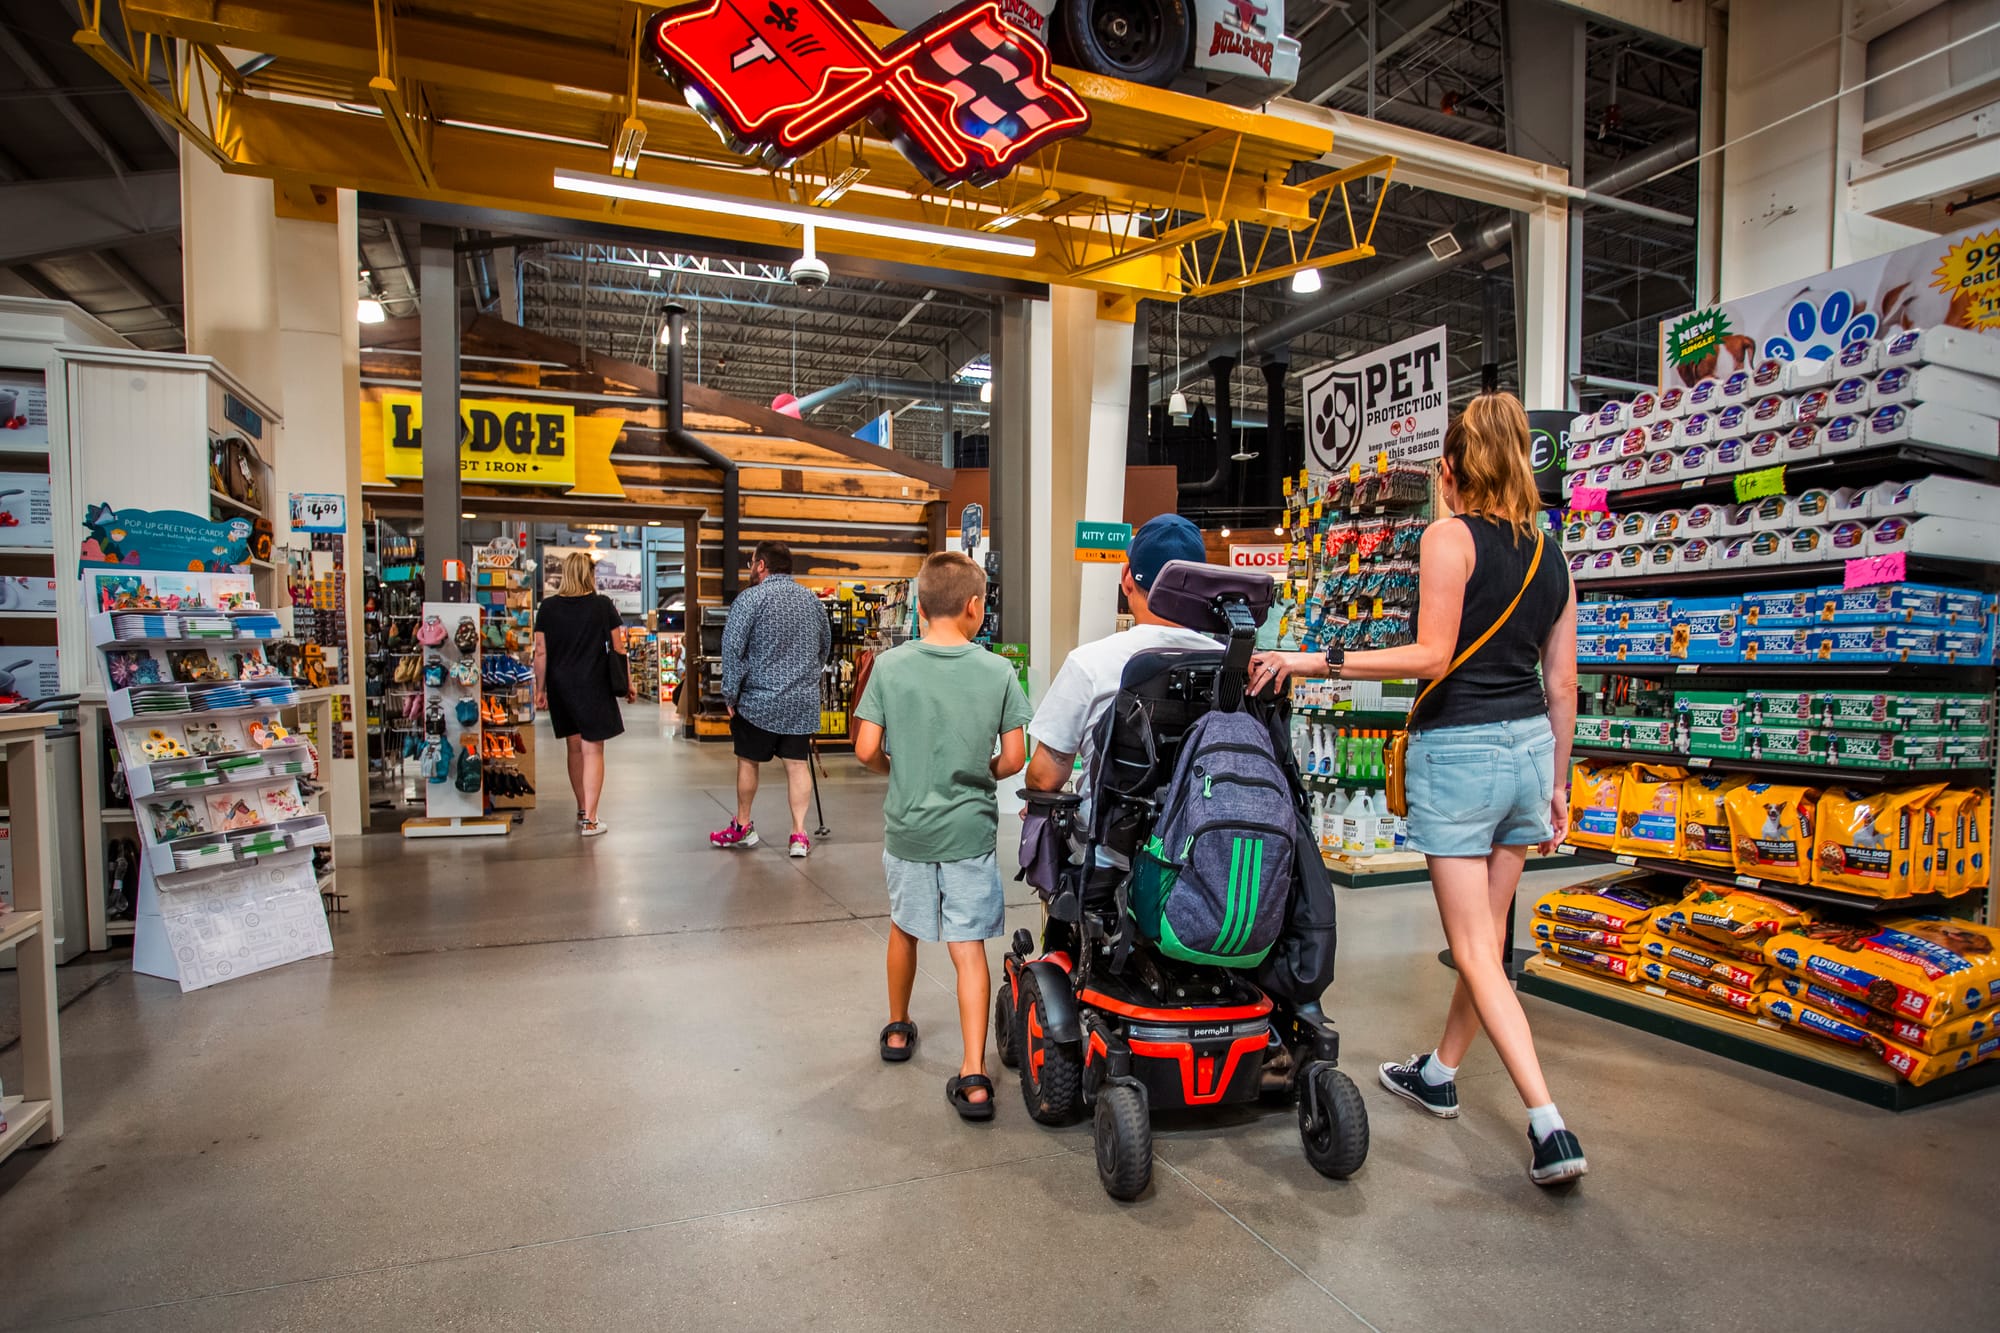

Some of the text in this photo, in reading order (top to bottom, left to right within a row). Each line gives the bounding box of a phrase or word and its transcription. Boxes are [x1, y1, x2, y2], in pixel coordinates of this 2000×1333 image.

[1678, 317, 1714, 344] NEW
[1366, 342, 1441, 410] PET
[1366, 392, 1442, 427] PROTECTION
[391, 404, 565, 456] LDGE
[1368, 428, 1440, 452] keep your furry friends
[1388, 447, 1405, 459] this
[1407, 439, 1440, 455] season
[485, 461, 527, 472] IRON
[157, 522, 198, 536] GREETING
[198, 527, 225, 538] CARDS
[1082, 531, 1126, 542] KITTY CITY
[1234, 553, 1298, 567] CLOSE
[1765, 605, 1789, 614] PACK
[1843, 600, 1871, 609] PACK
[1690, 617, 1718, 625] VARIETY
[1691, 624, 1716, 633] PACK
[1764, 642, 1789, 650] PACK
[1840, 640, 1867, 648] PACK
[1692, 710, 1720, 718] VARIETY
[1769, 705, 1793, 714] PACK
[1840, 706, 1868, 716] PACK
[1694, 717, 1718, 726] PACK
[1768, 740, 1793, 749] PACK
[1846, 745, 1874, 754] PACK
[1755, 841, 1779, 849] SMALL
[1845, 848, 1872, 857] SMALL
[1891, 933, 1967, 965] ADULT
[1612, 960, 1624, 971] 14
[1809, 956, 1849, 975] ADULT
[1903, 993, 1924, 1009] 18
[1801, 1010, 1841, 1029] ADULT
[1194, 1025, 1230, 1037] permobil
[1900, 1024, 1920, 1039] 18
[1890, 1054, 1911, 1070] 18
